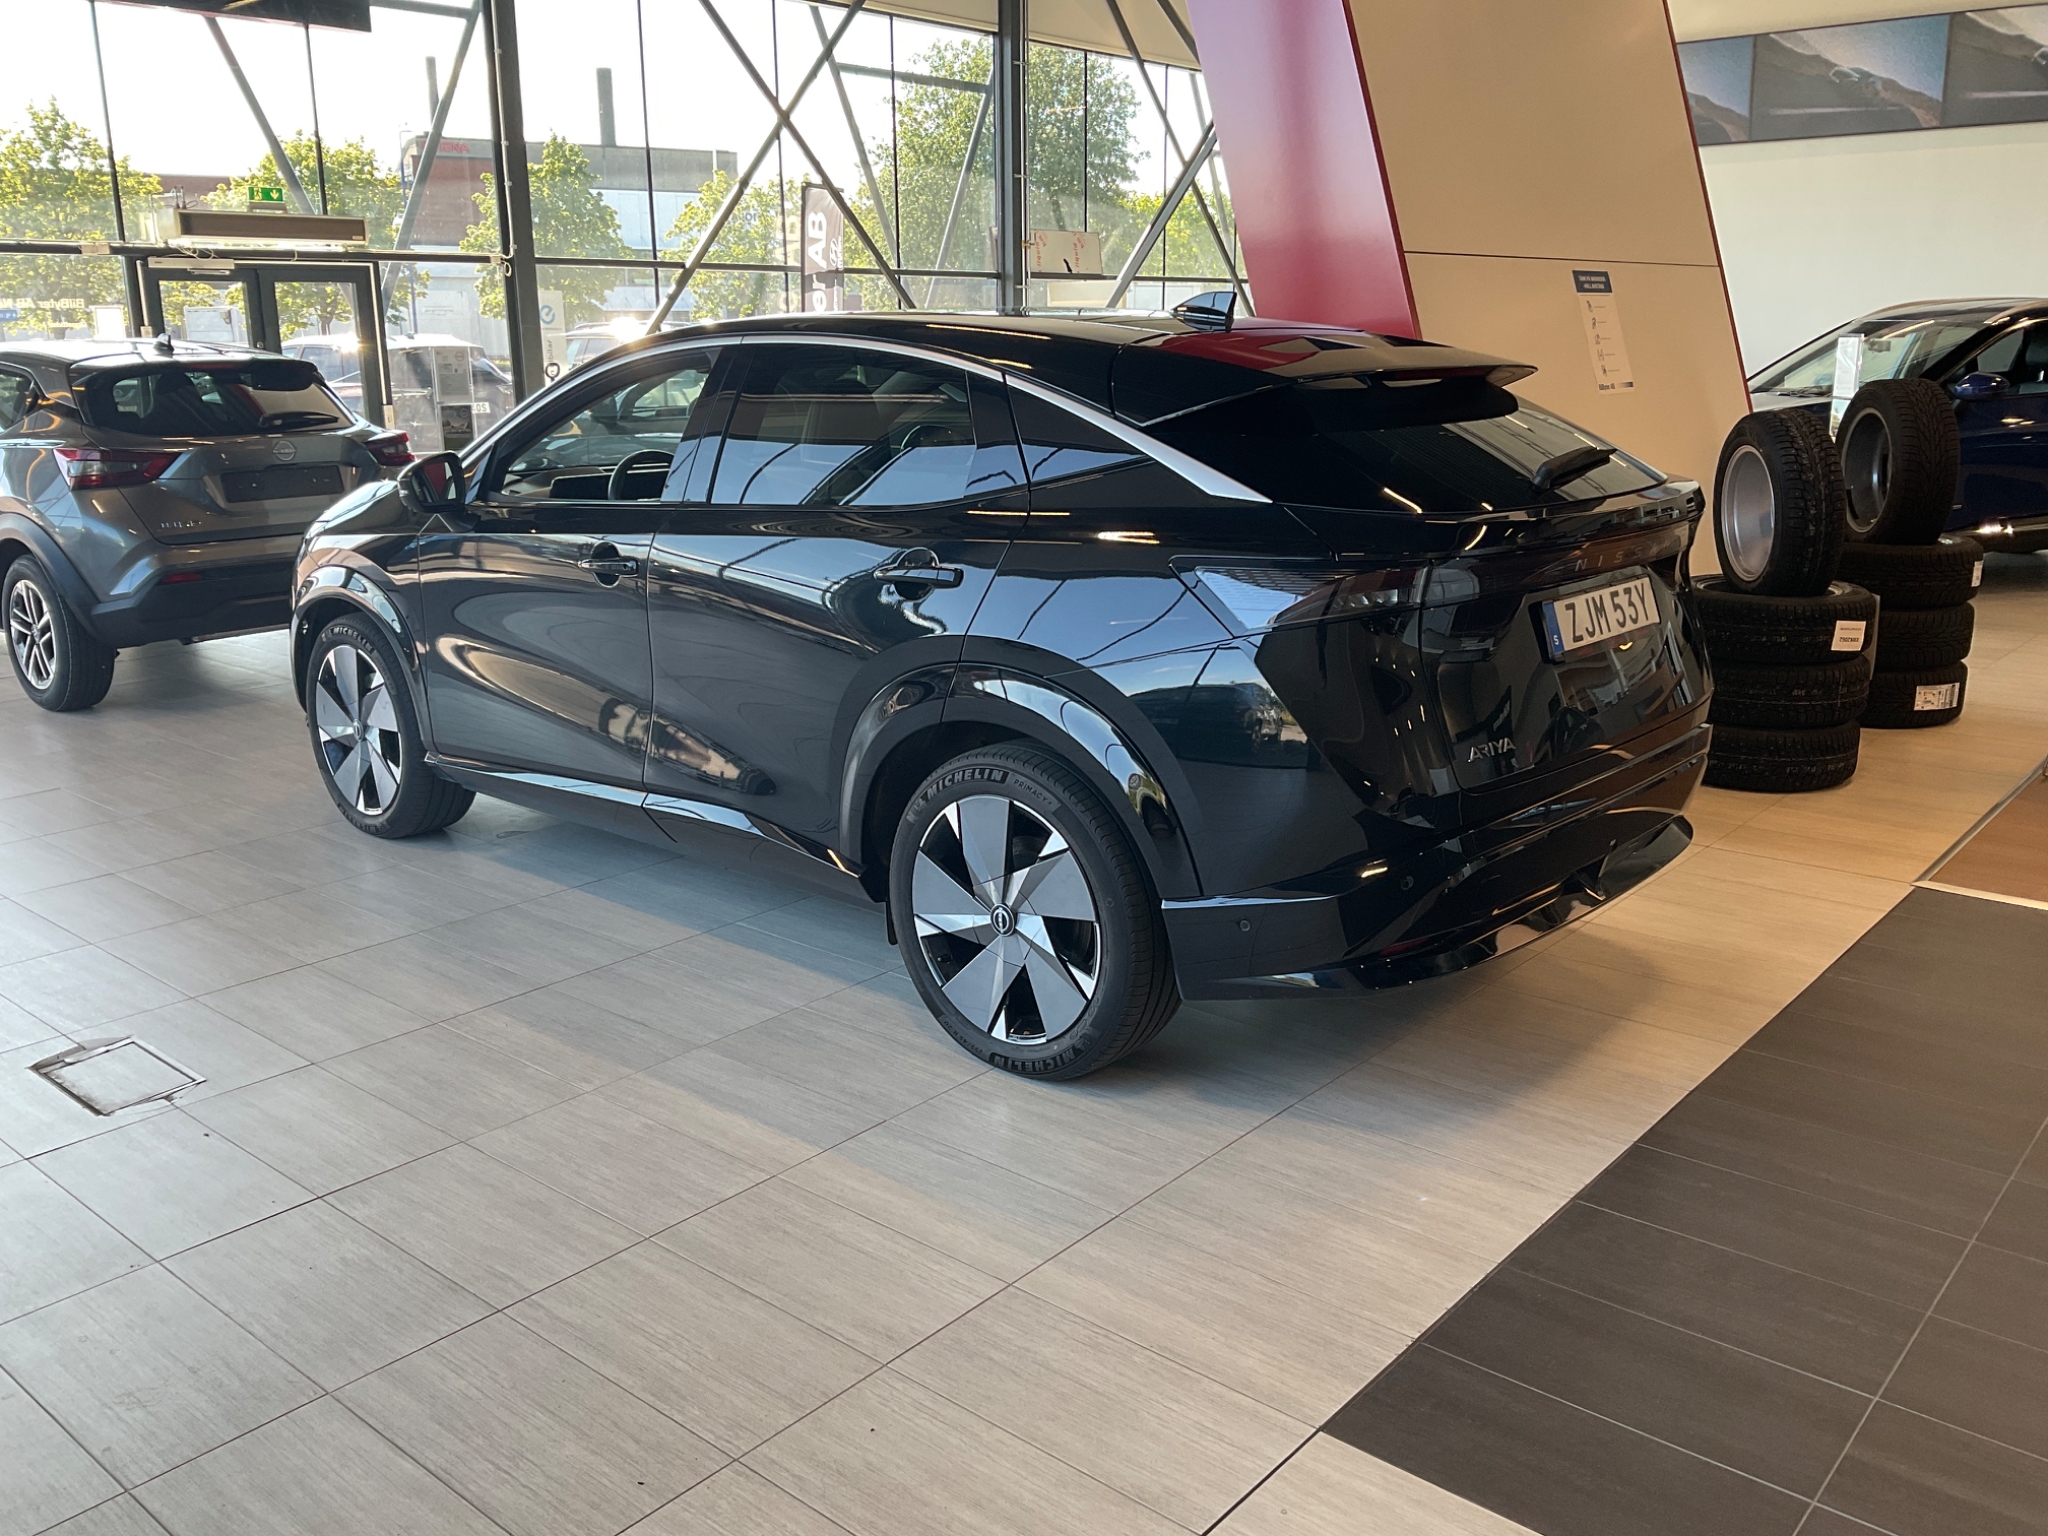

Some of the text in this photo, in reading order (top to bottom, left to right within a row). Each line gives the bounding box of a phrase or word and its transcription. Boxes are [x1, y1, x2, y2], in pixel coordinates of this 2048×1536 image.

[808, 211, 828, 270] AB
[1565, 582, 1649, 644] ZJM 53Y
[333, 626, 373, 652] MICHELIN
[1553, 635, 1559, 645] S
[1468, 738, 1517, 762] ARIYA
[927, 768, 1004, 799] MICHELIN
[1013, 779, 1048, 802] PRIMACY
[993, 1049, 1076, 1072] MICHELIN
